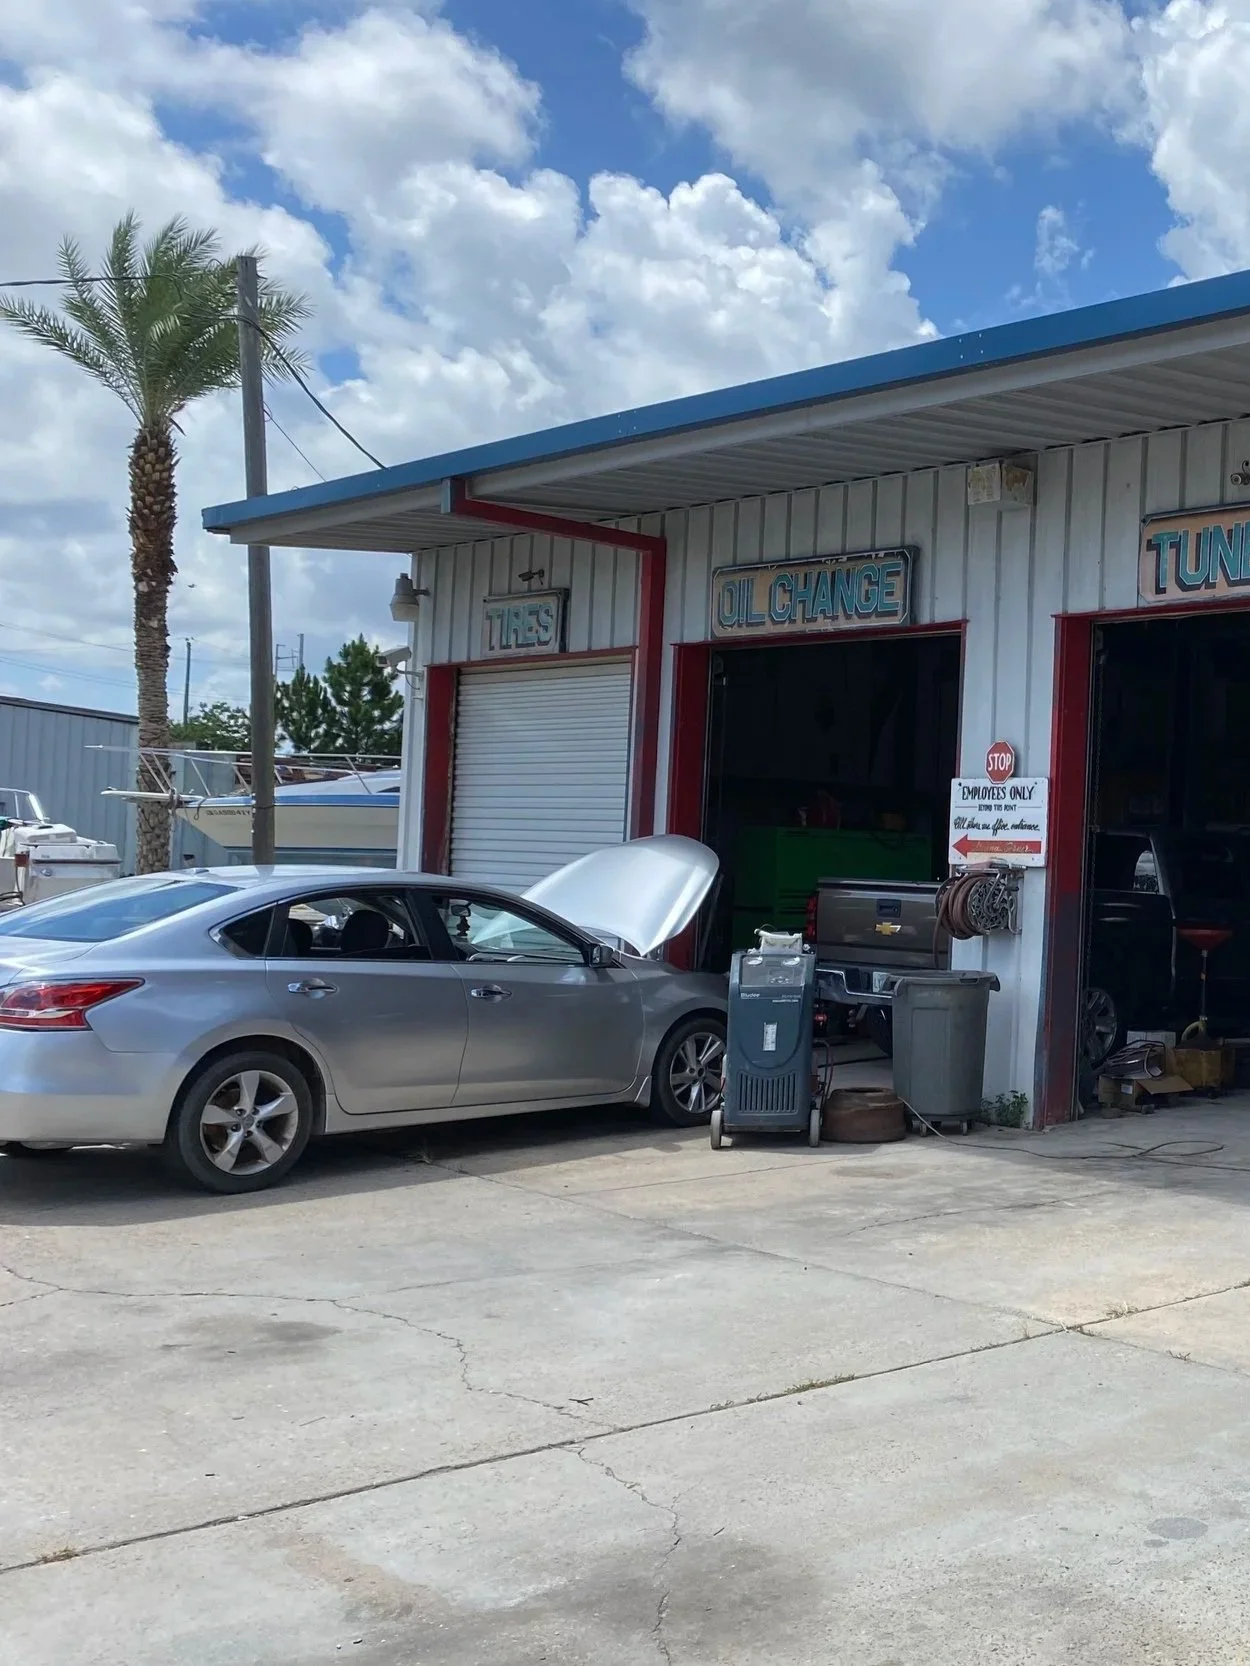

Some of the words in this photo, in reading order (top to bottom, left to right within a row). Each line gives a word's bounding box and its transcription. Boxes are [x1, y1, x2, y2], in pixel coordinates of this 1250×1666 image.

[719, 576, 766, 629] OIL
[769, 560, 903, 623] CHANGE
[485, 602, 554, 651] TIRES
[988, 753, 1012, 771] STOP
[962, 786, 1006, 800] EMPLOYEES
[1009, 786, 1035, 800] ONLY
